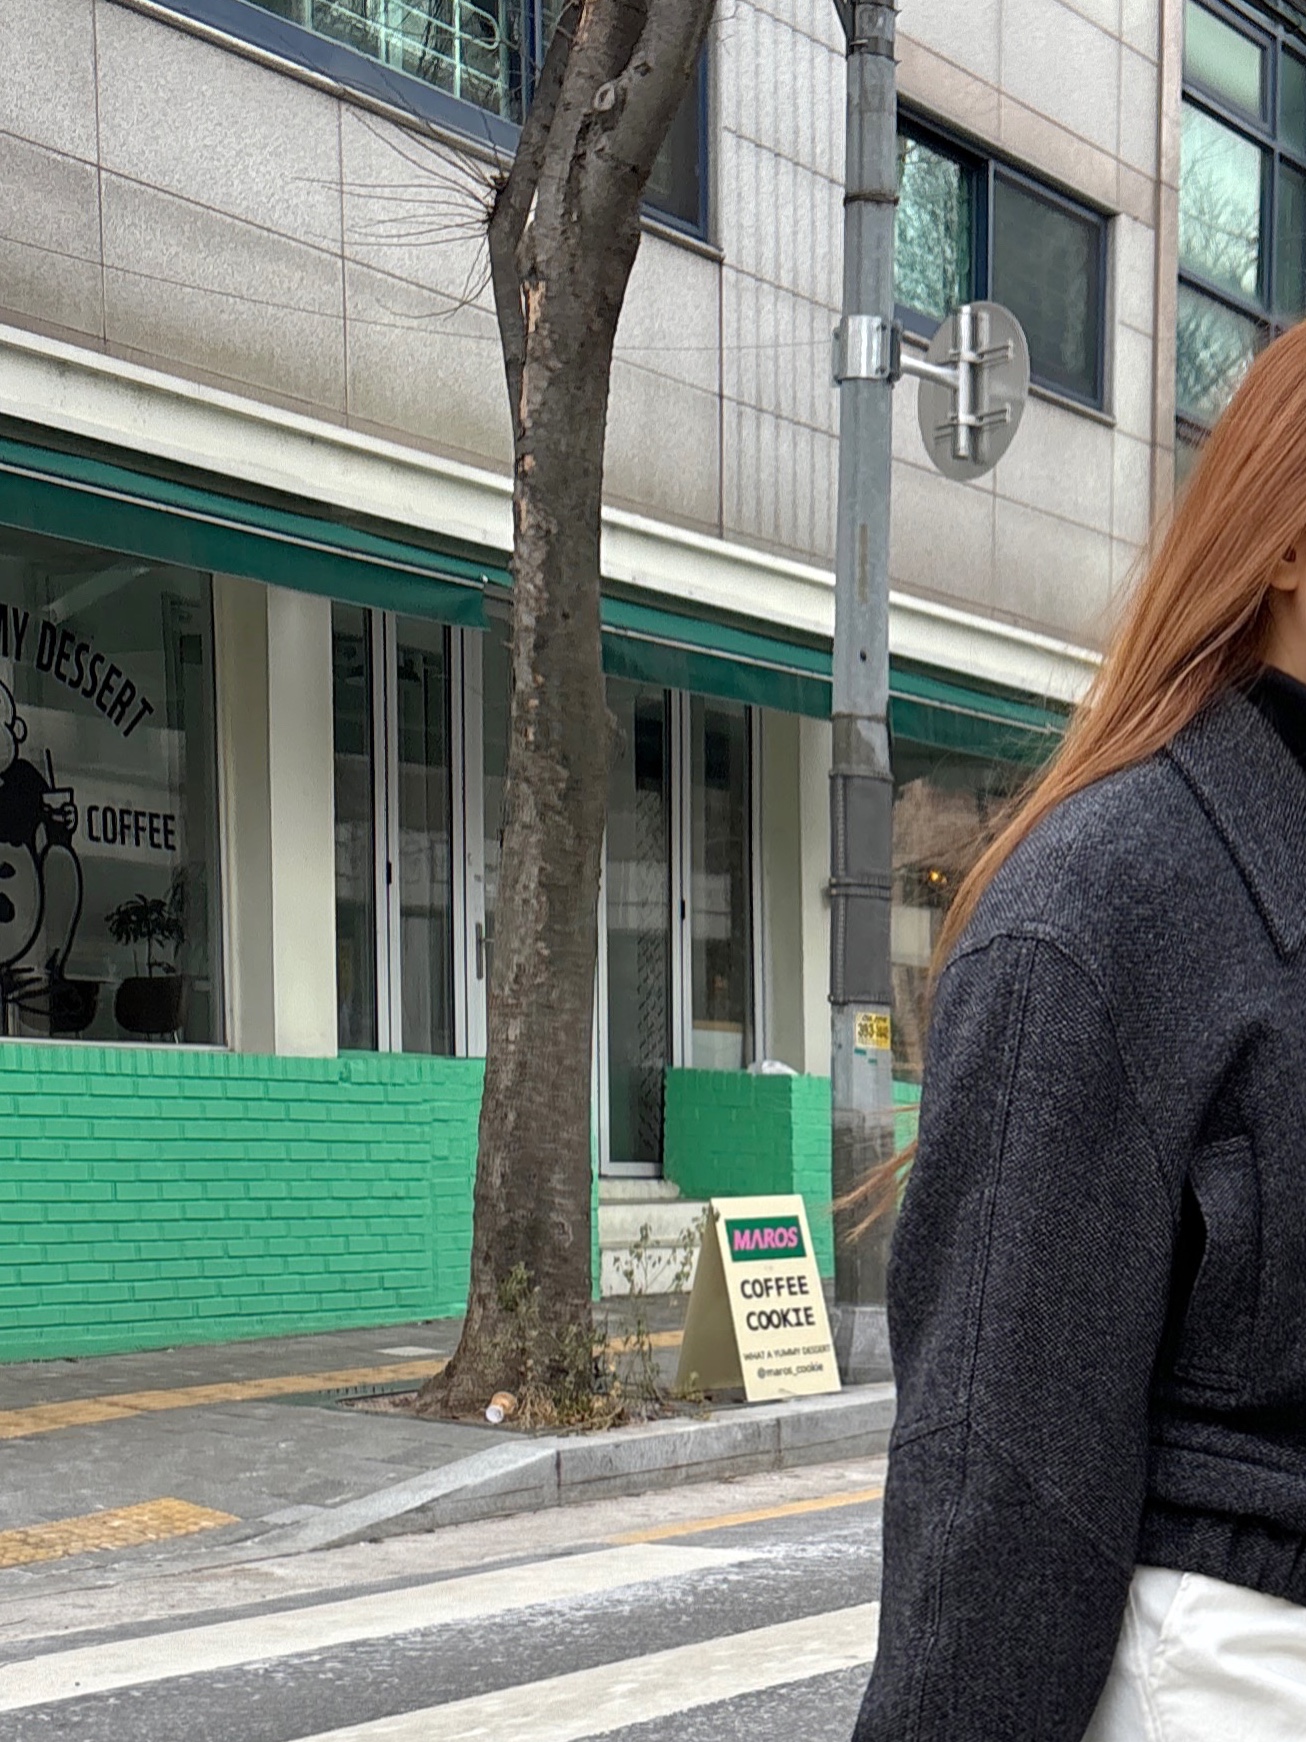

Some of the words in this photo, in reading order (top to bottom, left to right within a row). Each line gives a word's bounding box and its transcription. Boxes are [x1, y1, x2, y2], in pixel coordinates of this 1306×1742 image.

[36, 619, 155, 738] DESSERT
[87, 804, 177, 851] COFFEE
[733, 1226, 799, 1251] MAROS
[740, 1275, 810, 1299] COFFEE
[746, 1306, 816, 1331] COOKIE
[743, 1350, 765, 1361] WHAT
[767, 1350, 773, 1359] A
[757, 1361, 824, 1379] @maros_cookie
